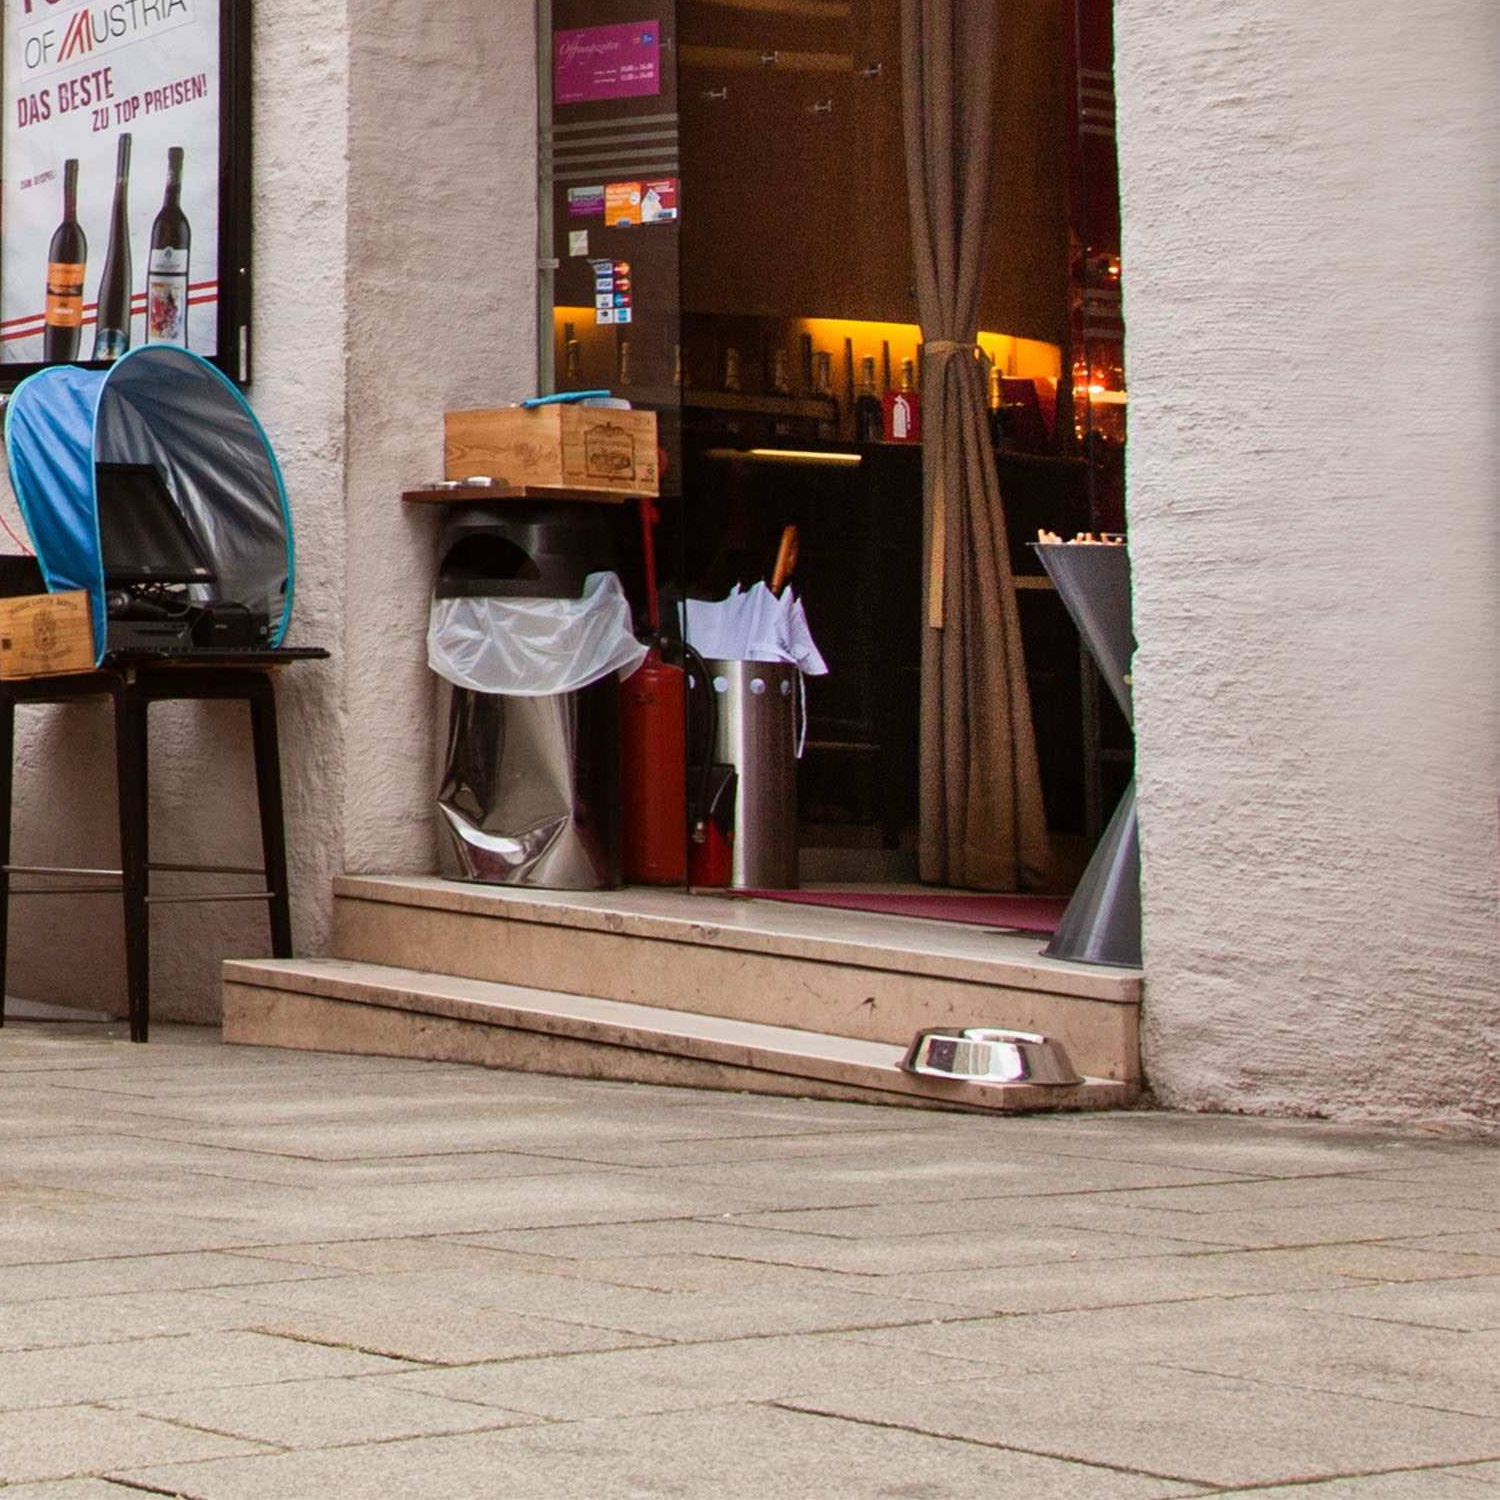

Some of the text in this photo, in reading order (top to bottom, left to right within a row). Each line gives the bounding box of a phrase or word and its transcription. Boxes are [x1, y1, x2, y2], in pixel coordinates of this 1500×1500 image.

[24, 29, 56, 69] OF
[17, 66, 115, 129] DAS BESTE
[92, 73, 208, 132] ZU TOP PREISEN!
